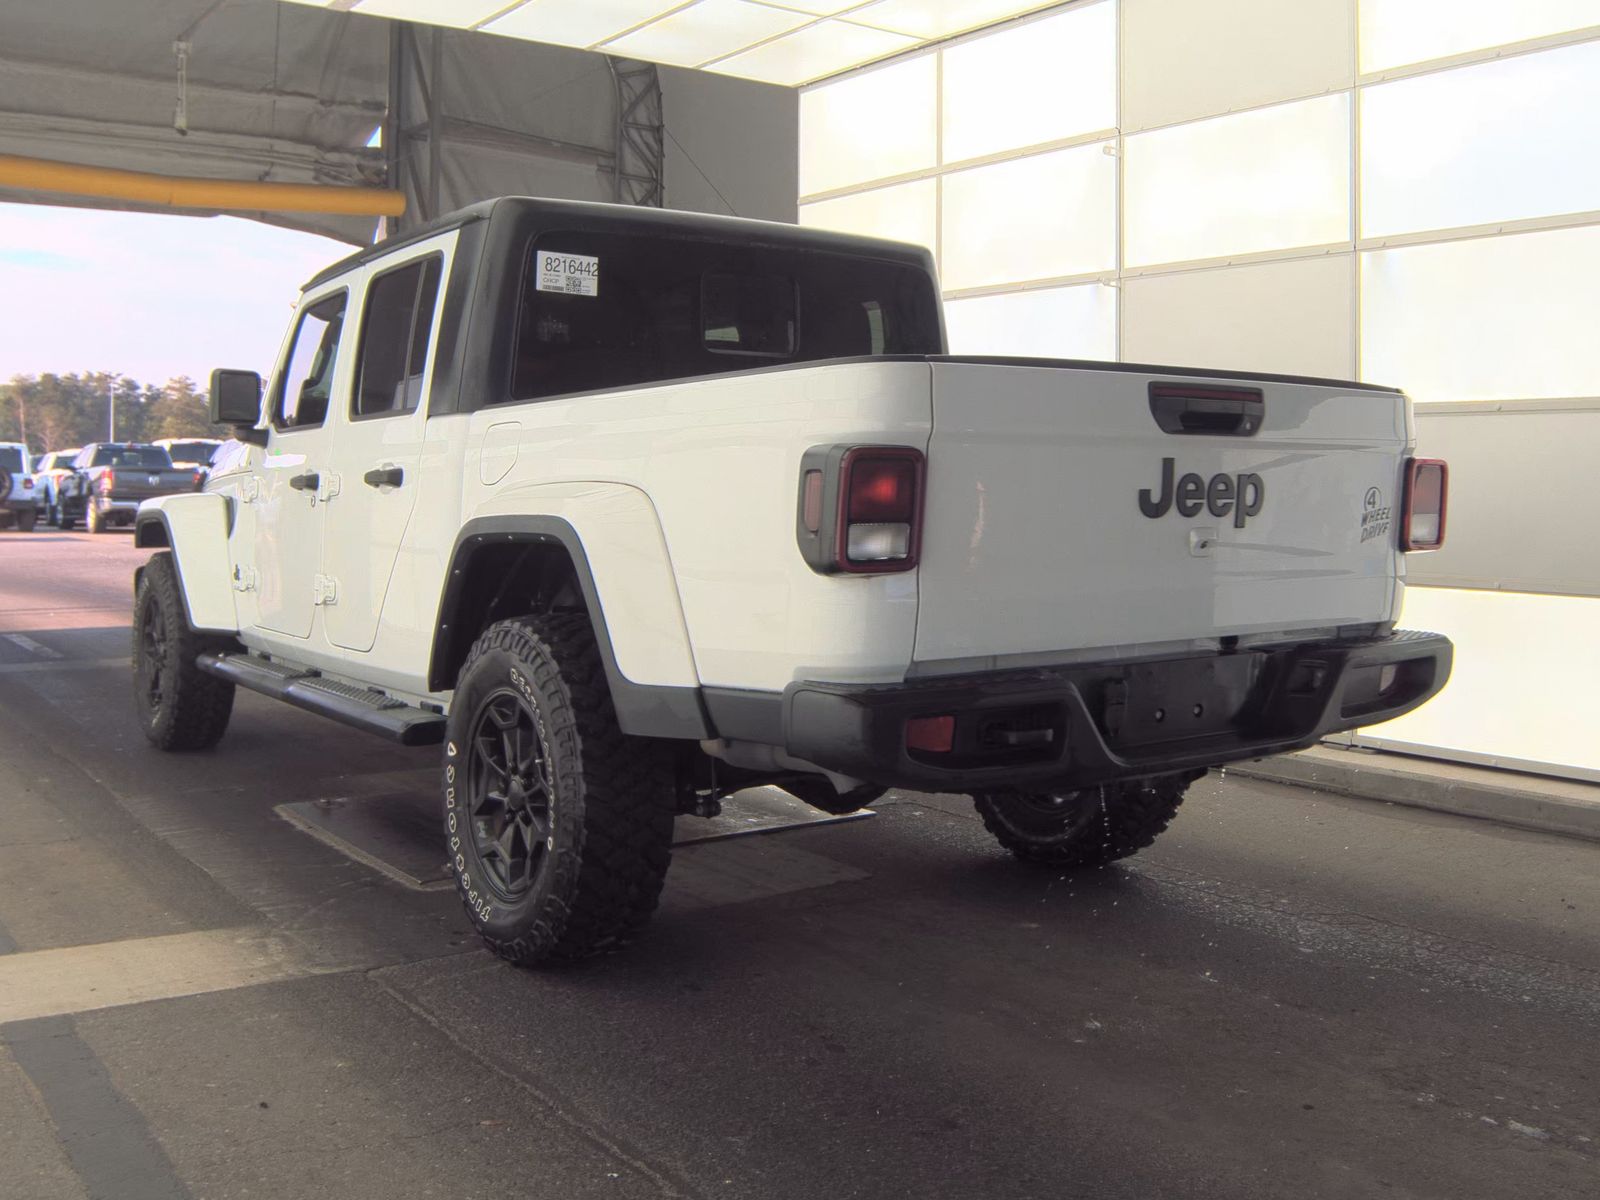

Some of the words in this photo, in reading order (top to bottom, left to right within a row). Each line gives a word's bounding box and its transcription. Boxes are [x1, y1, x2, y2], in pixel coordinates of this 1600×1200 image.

[545, 256, 600, 277] 8216442
[1138, 457, 1265, 528] Jeep
[1360, 507, 1391, 527] WHEEL
[1360, 521, 1390, 544] DRIVE
